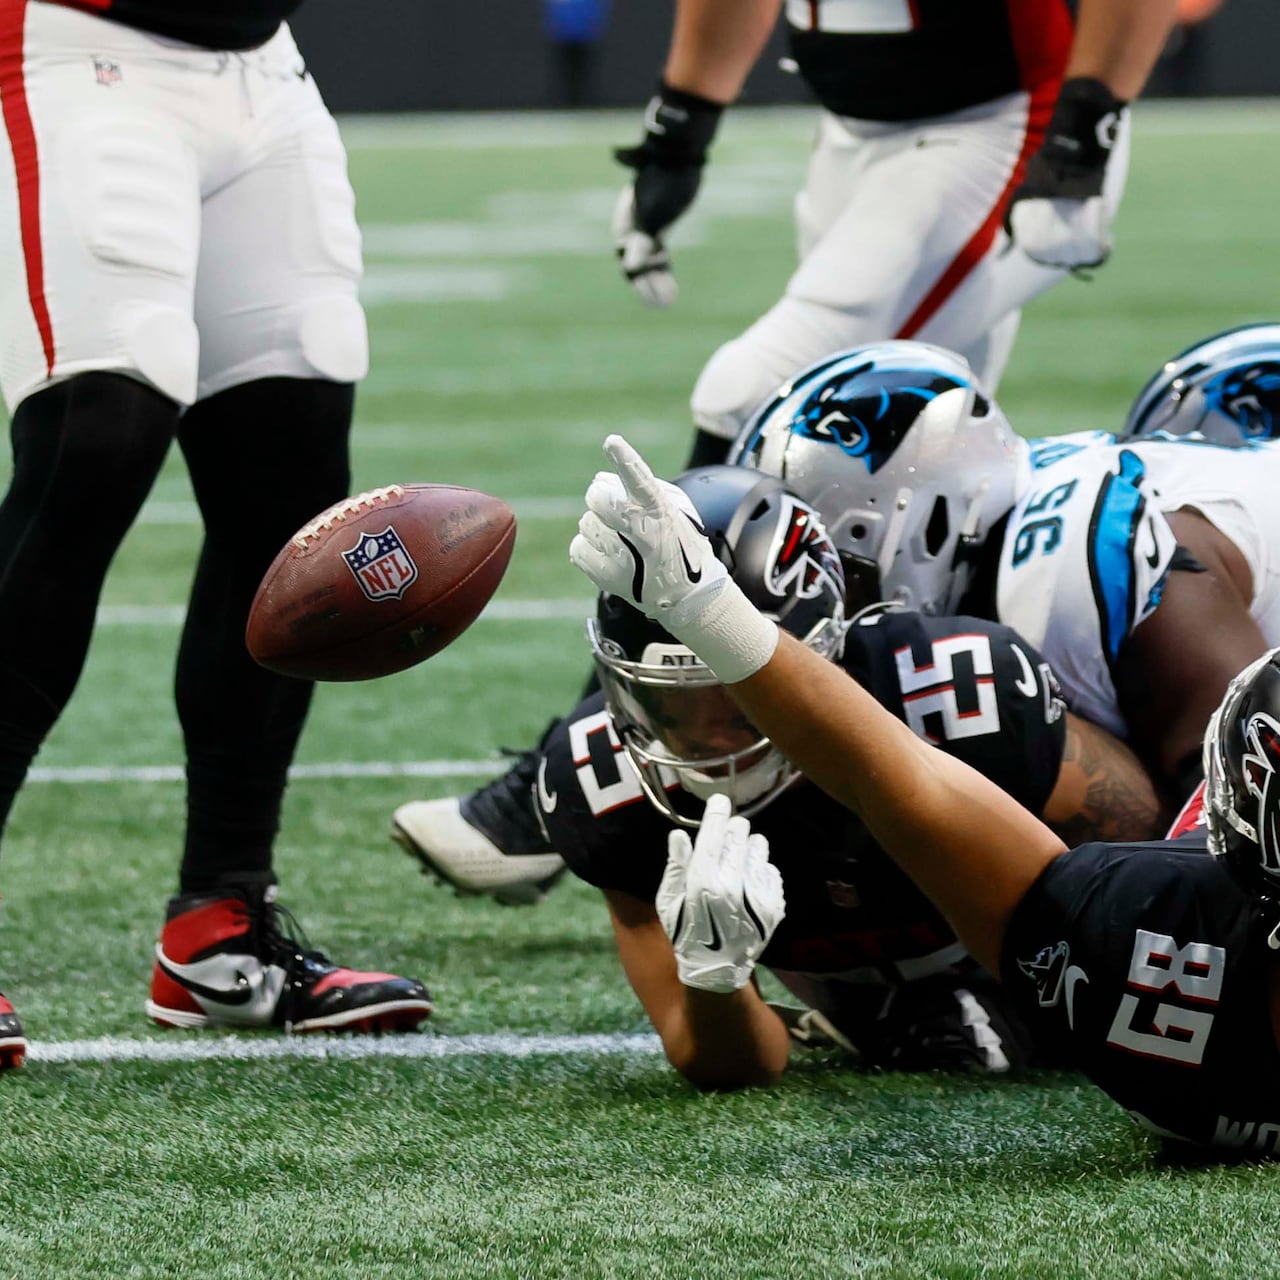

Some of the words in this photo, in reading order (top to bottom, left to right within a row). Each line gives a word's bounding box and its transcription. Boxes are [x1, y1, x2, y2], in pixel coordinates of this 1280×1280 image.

[360, 553, 411, 594] NFL
[893, 632, 1000, 746] 25
[1106, 929, 1226, 1067] 89
